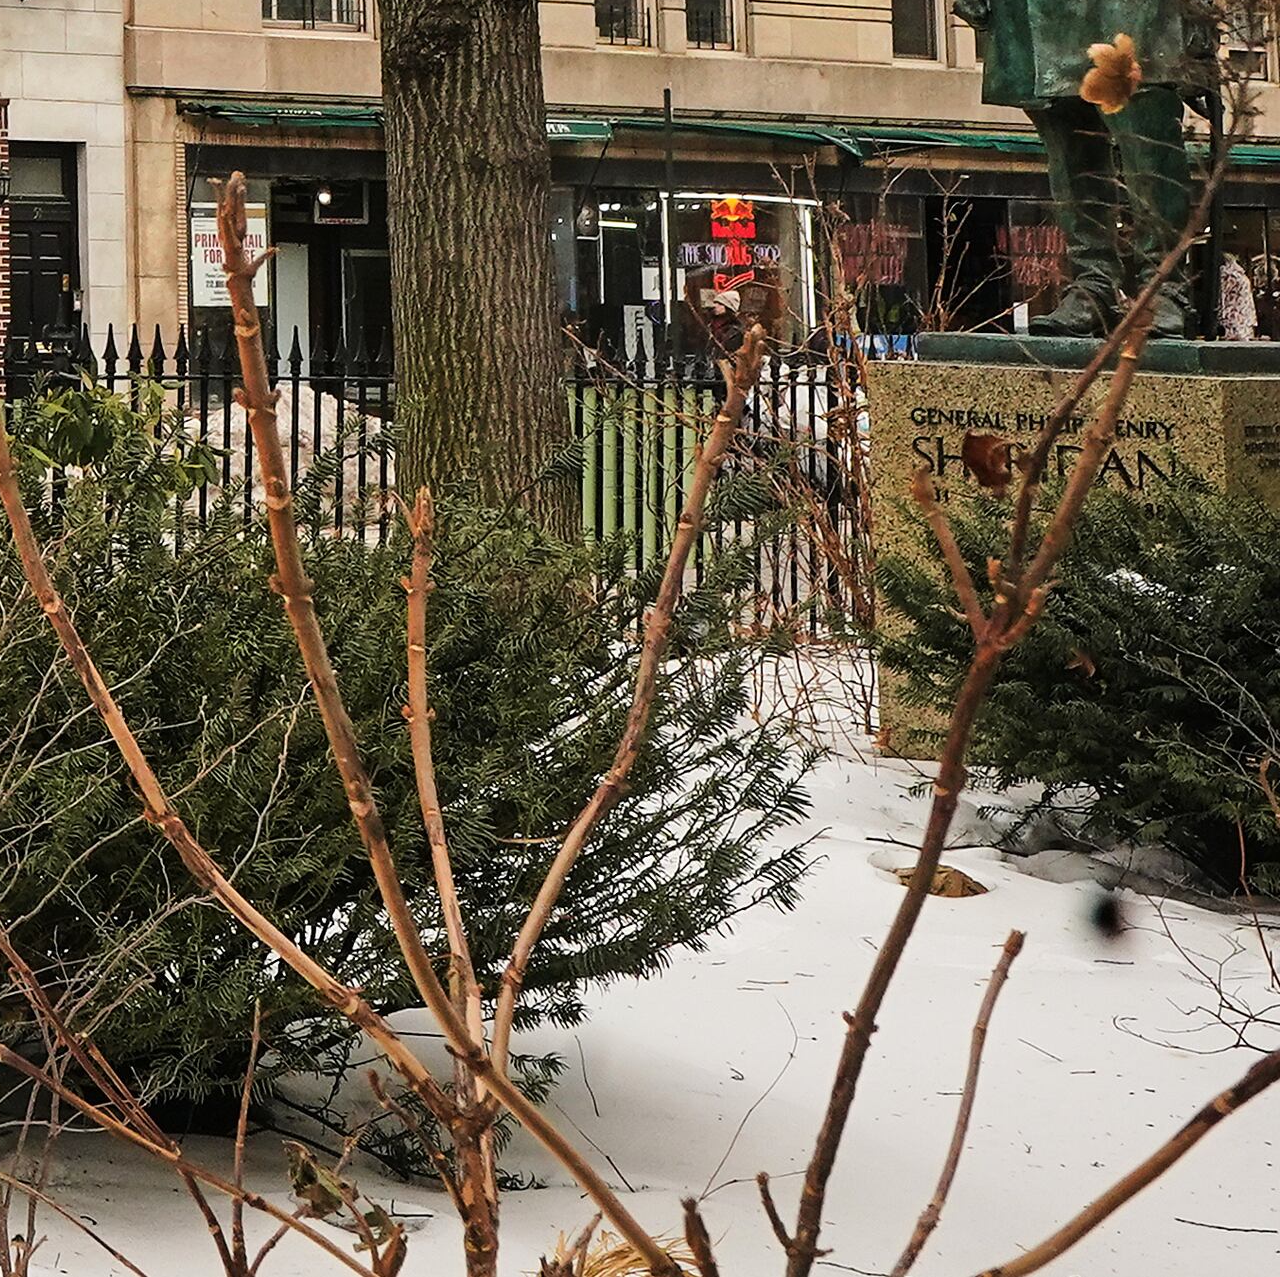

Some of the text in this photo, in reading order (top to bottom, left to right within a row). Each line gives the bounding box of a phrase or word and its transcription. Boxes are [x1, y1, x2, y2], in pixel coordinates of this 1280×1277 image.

[203, 248, 223, 263] FOR
[910, 406, 1007, 431] GENERAL
[1114, 418, 1176, 443] ENRY
